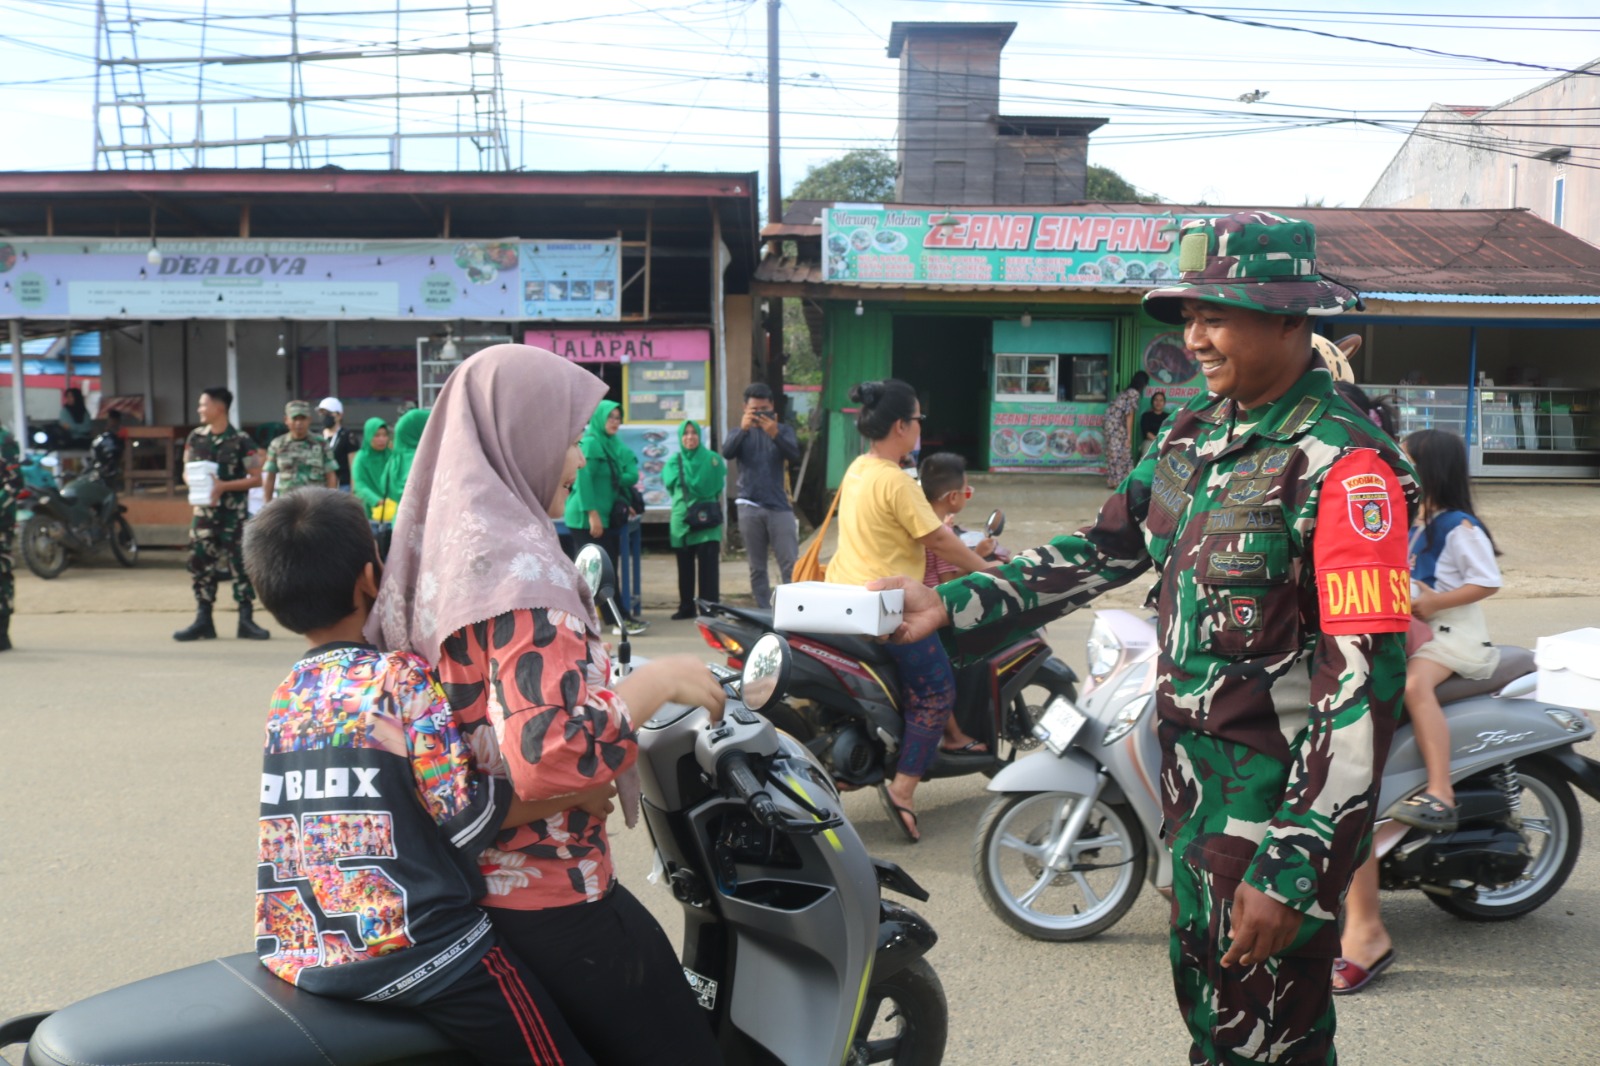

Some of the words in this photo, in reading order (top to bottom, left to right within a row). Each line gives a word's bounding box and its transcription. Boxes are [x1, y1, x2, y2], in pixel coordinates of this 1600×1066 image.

[833, 211, 878, 229] Warung
[884, 211, 922, 227] Makan
[923, 214, 1034, 249] ZEANA
[1034, 216, 1176, 252] SIMPANG
[224, 257, 307, 275] LOVA
[994, 414, 1029, 426] ZEANA
[1031, 414, 1074, 426] SIMPANG
[1211, 512, 1235, 528] TNI
[1246, 511, 1274, 528] AD
[1326, 569, 1382, 616] DAN
[1389, 568, 1411, 616] SS
